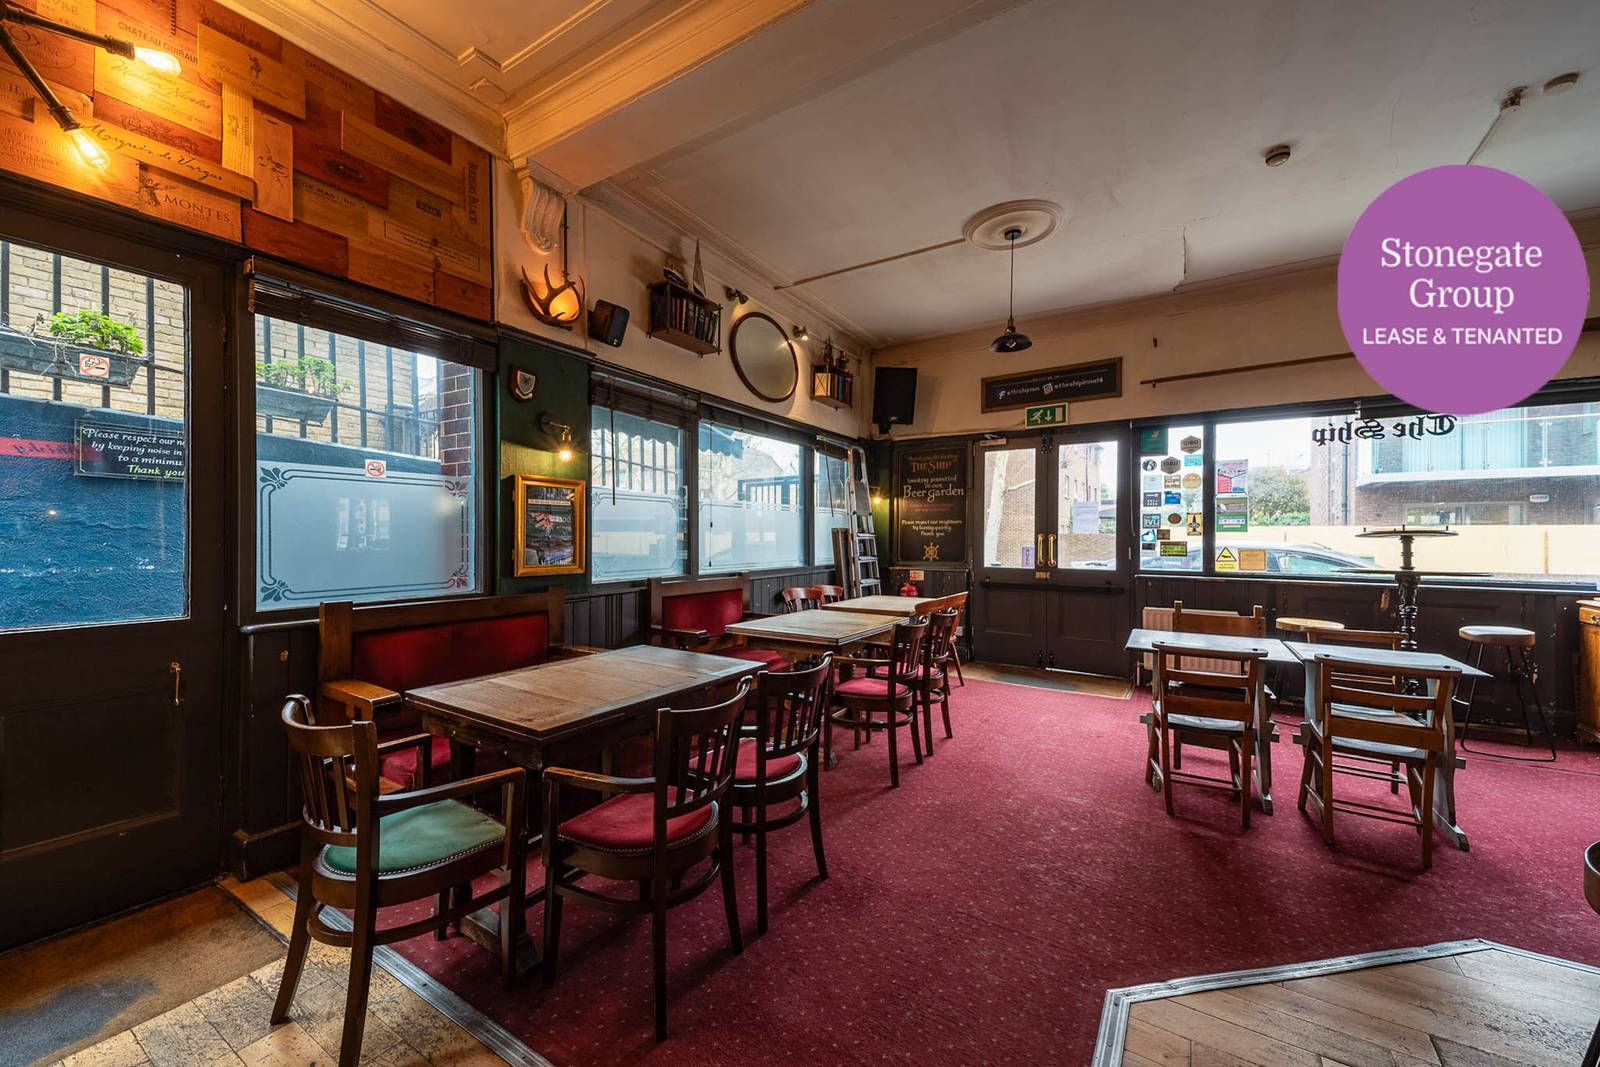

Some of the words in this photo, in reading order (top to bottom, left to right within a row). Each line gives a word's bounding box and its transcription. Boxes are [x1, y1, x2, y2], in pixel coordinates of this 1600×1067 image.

[118, 21, 161, 47] CHATEAU
[163, 42, 198, 65] GUIRAU
[164, 194, 231, 223] MONTES
[82, 427, 120, 440] Please
[122, 434, 157, 444] respect
[158, 438, 175, 446] our
[91, 441, 105, 452] by
[107, 441, 146, 455] keeping
[147, 447, 171, 455] noise
[173, 448, 182, 456] in
[117, 454, 129, 462] to
[141, 457, 184, 466] minimu
[928, 461, 952, 473] SHIP
[127, 464, 161, 475] Thank
[903, 484, 927, 498] Beer
[928, 483, 965, 502] garden
